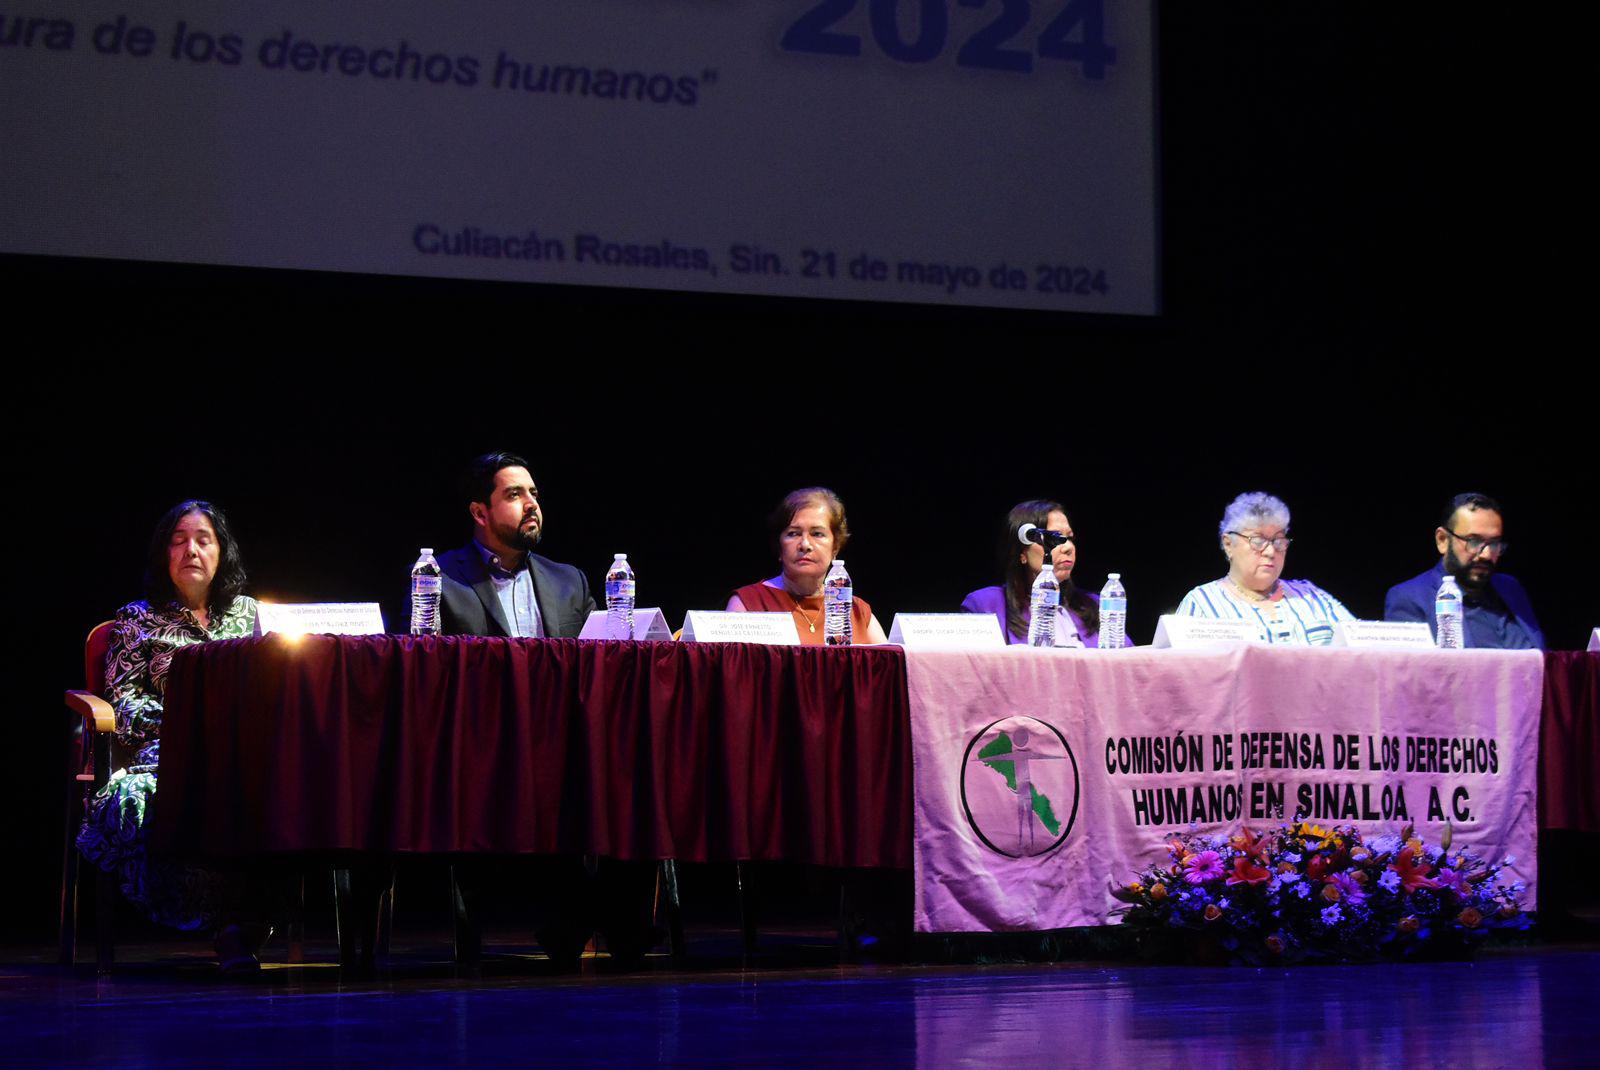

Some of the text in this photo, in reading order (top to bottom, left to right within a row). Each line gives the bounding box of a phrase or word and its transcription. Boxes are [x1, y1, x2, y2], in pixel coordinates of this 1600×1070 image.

[92, 14, 156, 57] de
[170, 20, 243, 66] los
[258, 29, 480, 87] derechos
[779, 0, 1117, 80] 2024
[412, 223, 1109, 296] Culiacán Rosales, Sin. 21 de mayo de 2024
[1105, 730, 1499, 775] COMISIÓN DE DEFENSA DE LOS DERECHOS
[1132, 783, 1243, 826] HUMANOS
[1249, 782, 1285, 819] EN
[1427, 786, 1475, 823] A.C.
